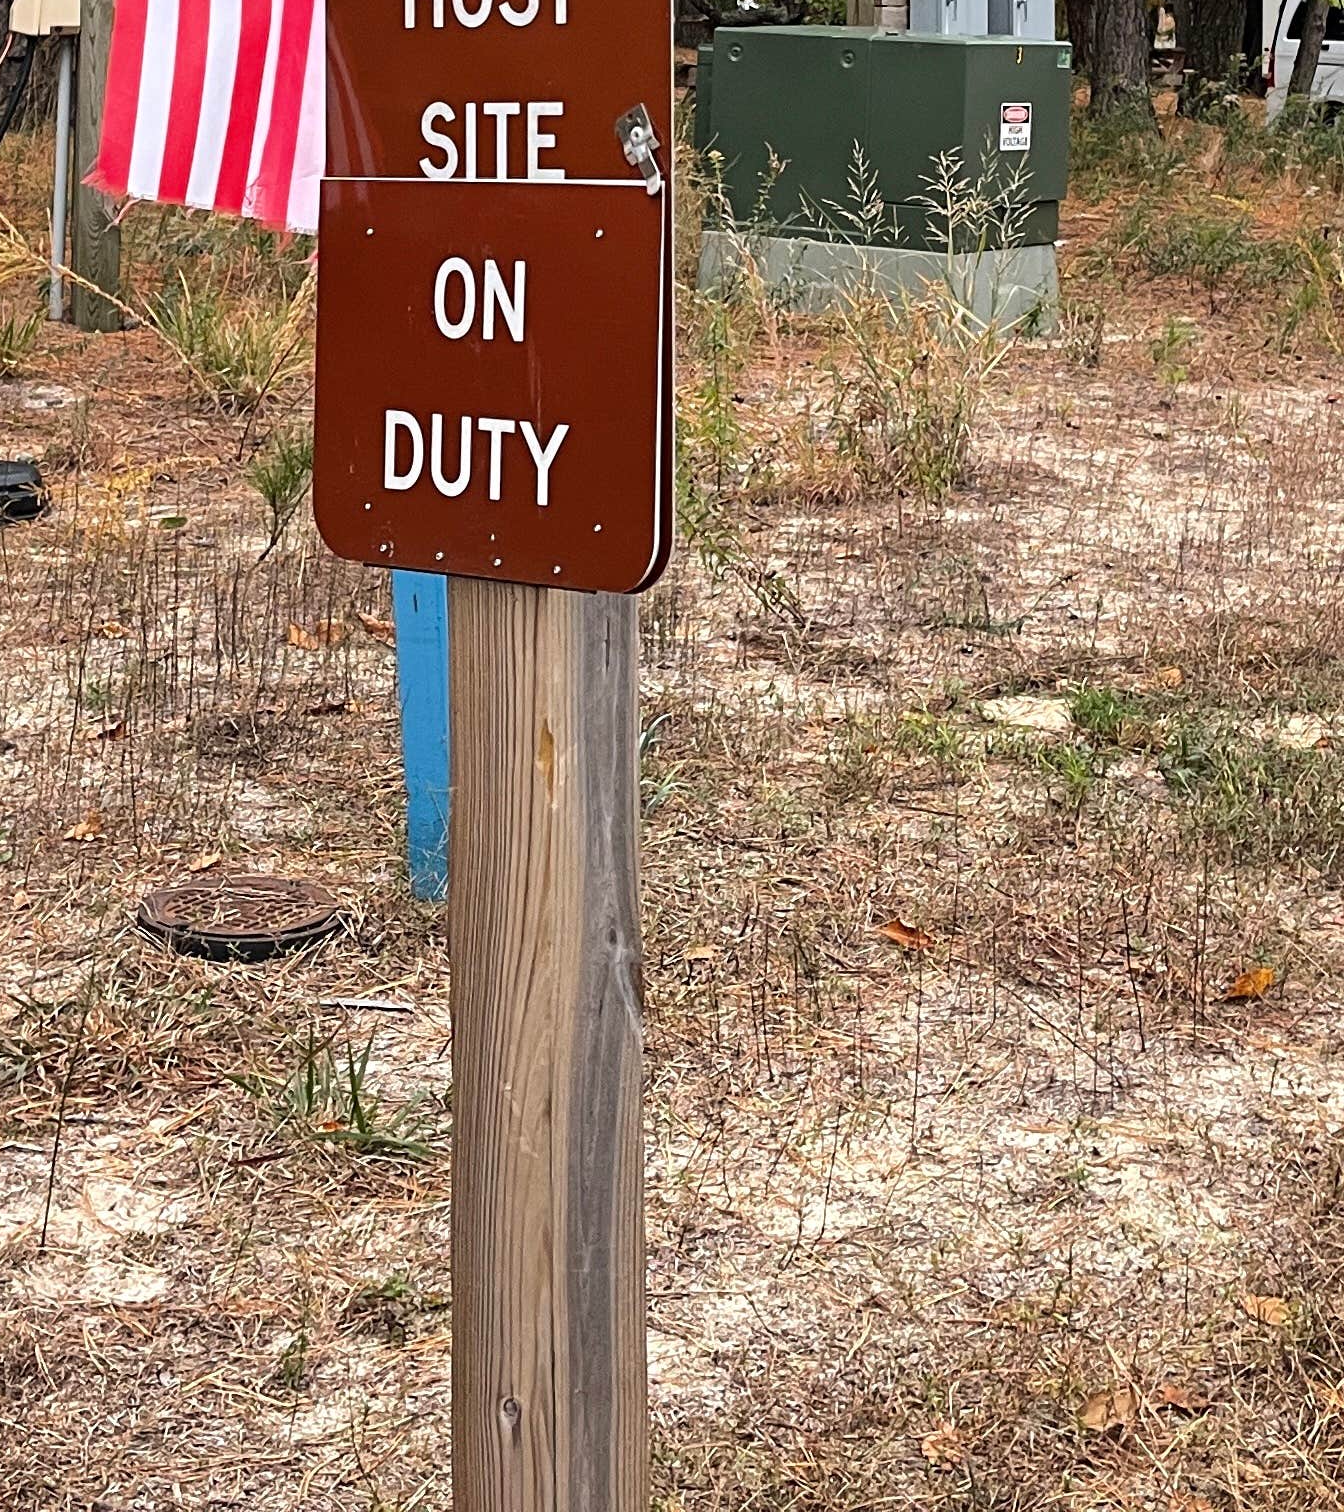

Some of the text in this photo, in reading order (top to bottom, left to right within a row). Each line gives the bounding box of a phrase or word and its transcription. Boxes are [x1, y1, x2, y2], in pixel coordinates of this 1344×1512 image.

[419, 101, 566, 180] SITE
[434, 256, 526, 343] ON
[384, 409, 570, 506] DUTY
